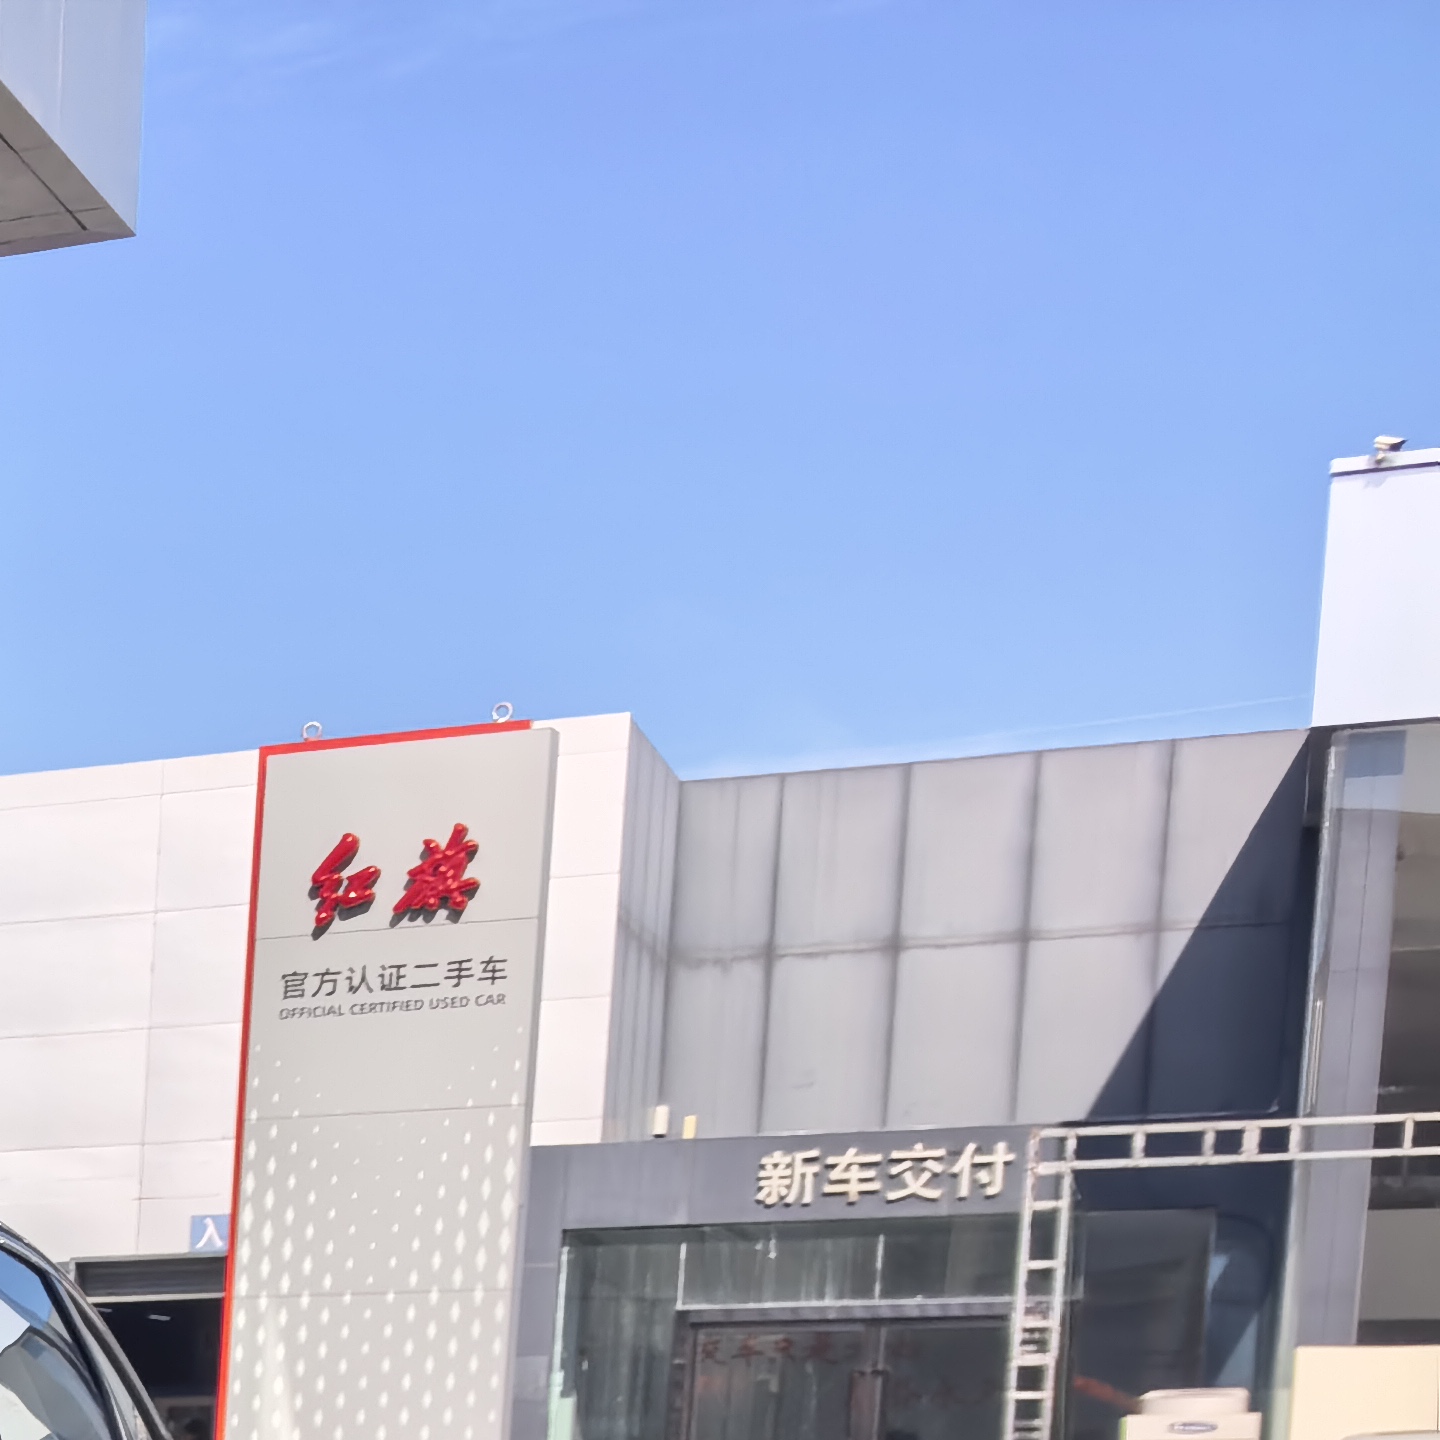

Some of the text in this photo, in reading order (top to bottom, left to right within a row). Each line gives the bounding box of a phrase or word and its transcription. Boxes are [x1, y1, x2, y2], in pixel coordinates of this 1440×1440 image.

[312, 823, 481, 927] 红旗
[280, 956, 508, 1000] 官方认证二手车
[279, 993, 507, 1021] OFFICIAL CERTIFIED USED CAR
[755, 1141, 1018, 1207] 新车交付
